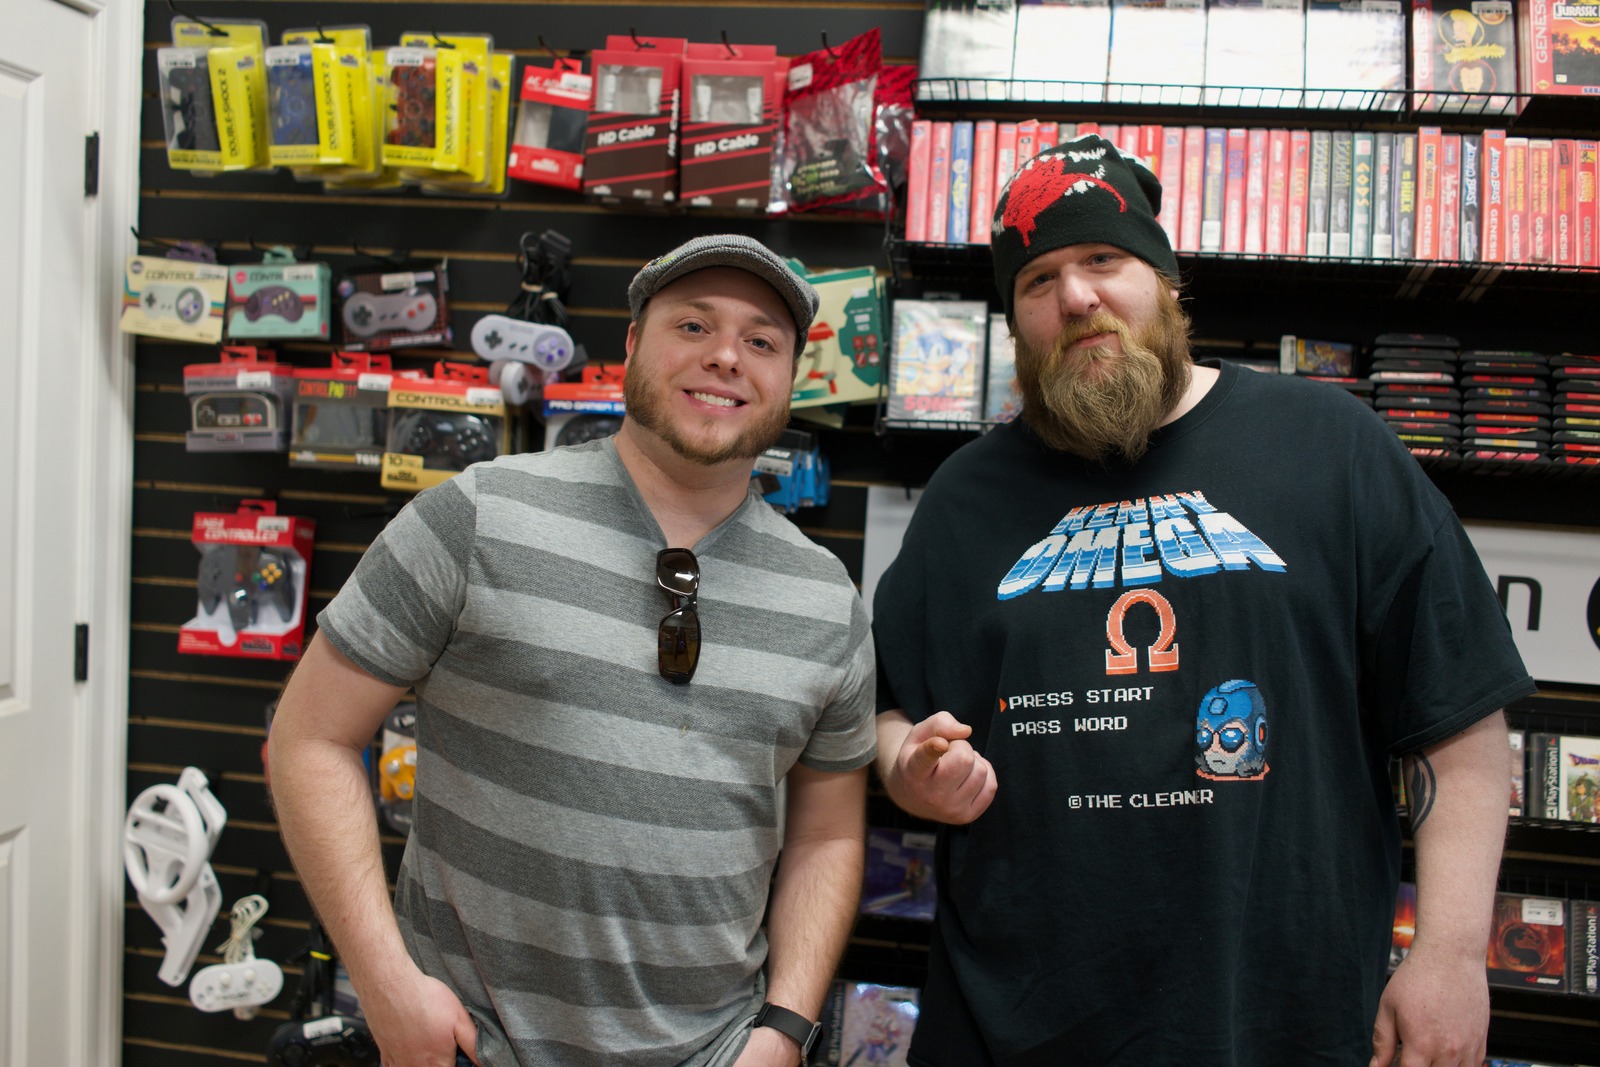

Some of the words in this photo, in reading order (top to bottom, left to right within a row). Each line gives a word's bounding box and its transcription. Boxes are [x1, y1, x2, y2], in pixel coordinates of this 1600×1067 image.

[1535, 0, 1548, 63] GENESI
[598, 131, 618, 146] HD
[618, 124, 656, 143] Cable
[694, 141, 718, 158] HD
[718, 133, 759, 153] Cable
[1355, 162, 1371, 207] GODS
[1423, 205, 1432, 256] GENESIS
[1489, 209, 1498, 259] GENESIS
[1050, 490, 1218, 534] KENNY
[997, 512, 1287, 600] OMEGA
[1009, 691, 1074, 710] PRESS
[1086, 686, 1154, 704] START
[1012, 719, 1061, 736] PASS
[1074, 715, 1128, 732] WORD
[1085, 794, 1122, 809] THE
[1586, 919, 1600, 974] PlayStation
